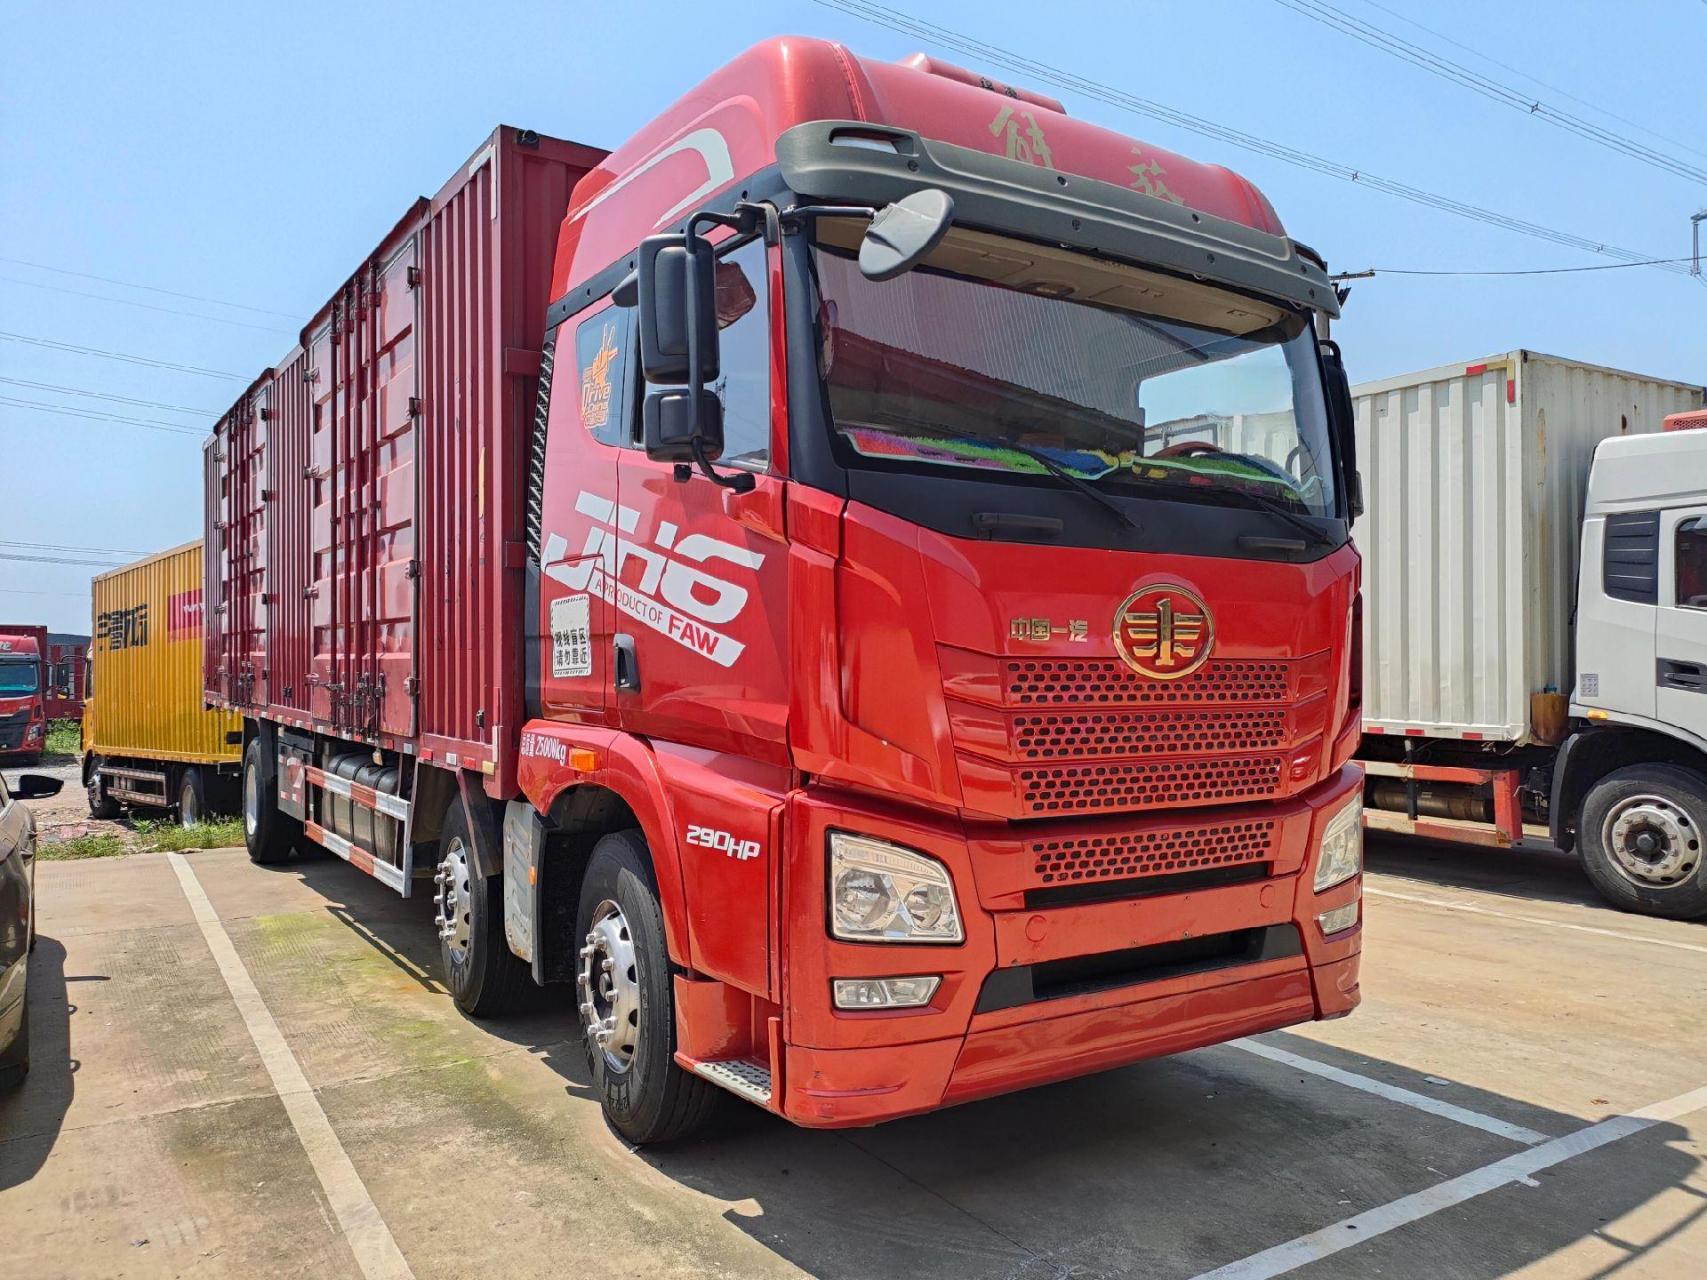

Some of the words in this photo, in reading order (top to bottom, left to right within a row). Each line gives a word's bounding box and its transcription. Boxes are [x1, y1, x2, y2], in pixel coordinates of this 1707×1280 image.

[604, 581, 648, 617] PRODUCT
[648, 607, 664, 625] OF
[668, 614, 721, 656] FAW
[1010, 617, 1089, 643] 中国一汽
[556, 646, 588, 667] 请勿靠近
[686, 824, 761, 861] 290HP
